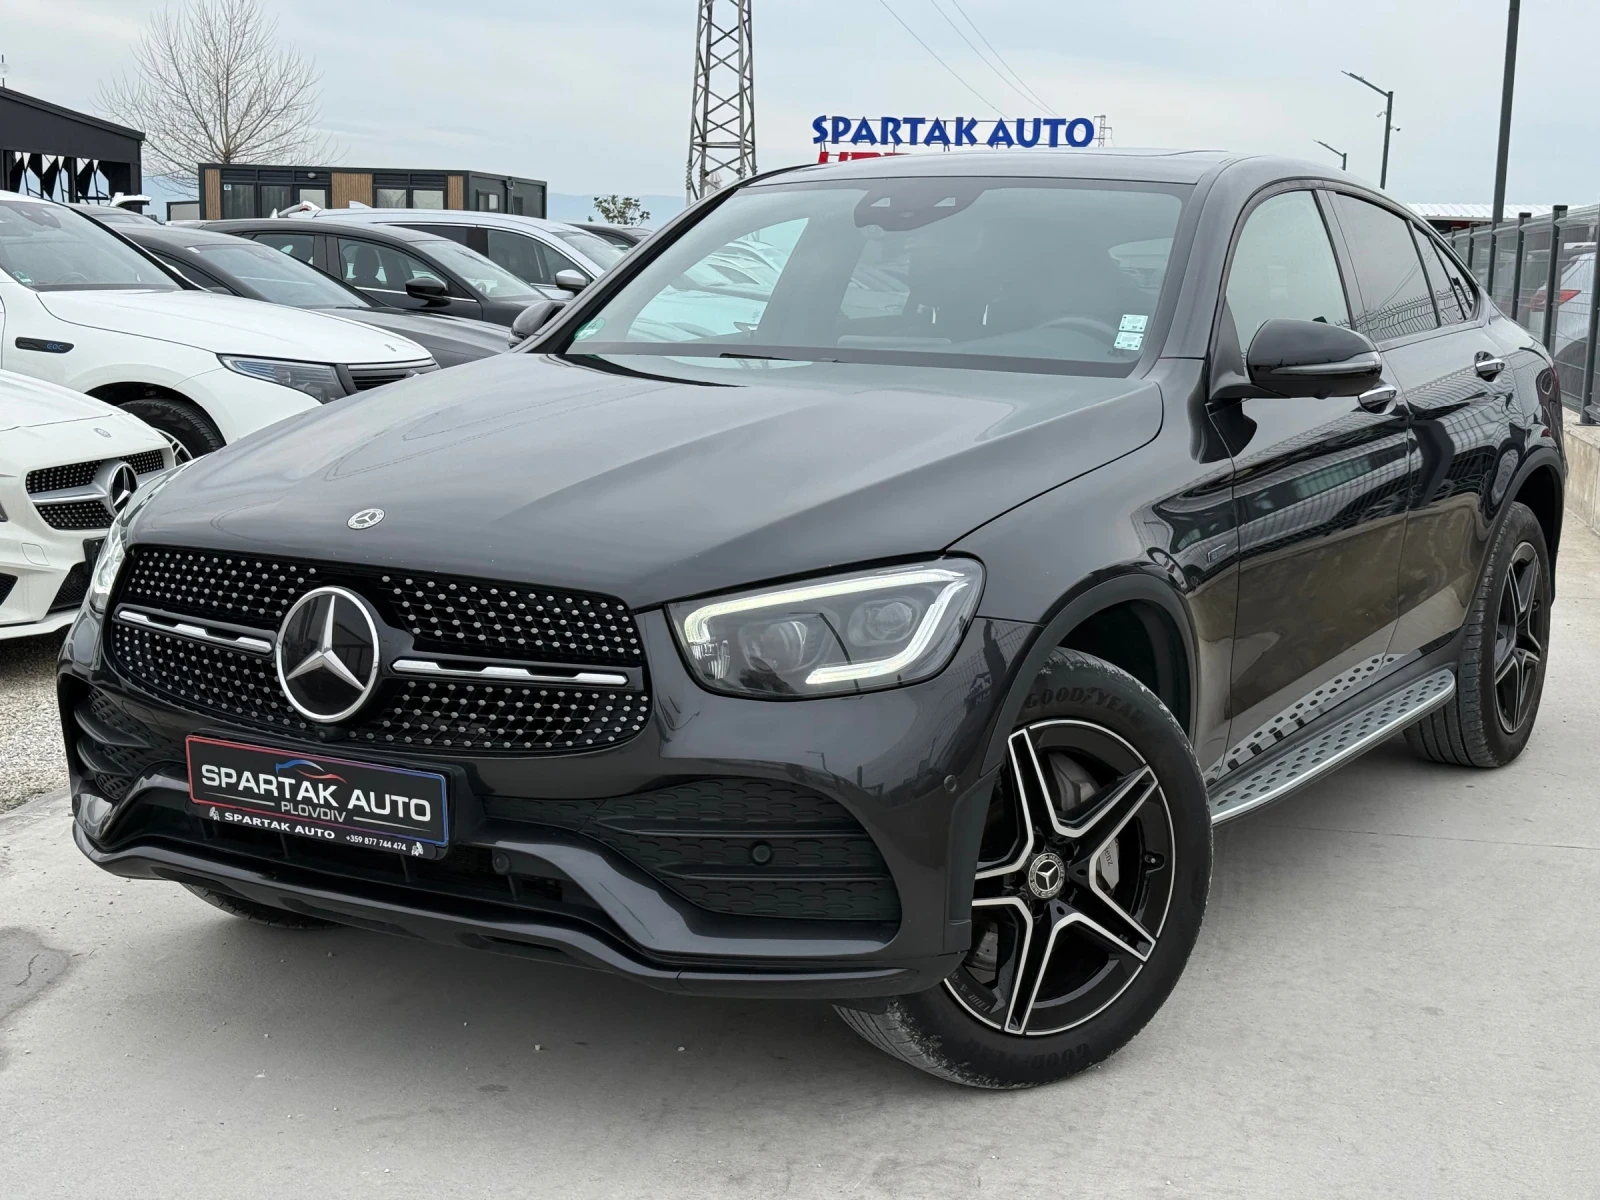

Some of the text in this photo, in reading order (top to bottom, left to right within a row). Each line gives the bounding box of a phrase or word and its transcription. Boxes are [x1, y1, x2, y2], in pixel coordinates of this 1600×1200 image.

[812, 115, 1094, 148] SPARTAK AUTO
[1024, 687, 1146, 723] GOODYEAR
[201, 764, 432, 822] SPARTAK AUTO
[224, 812, 336, 839] SPARTAK AUTO
[281, 801, 347, 823] PLOVDIV
[345, 834, 407, 851] +359 877 744 474
